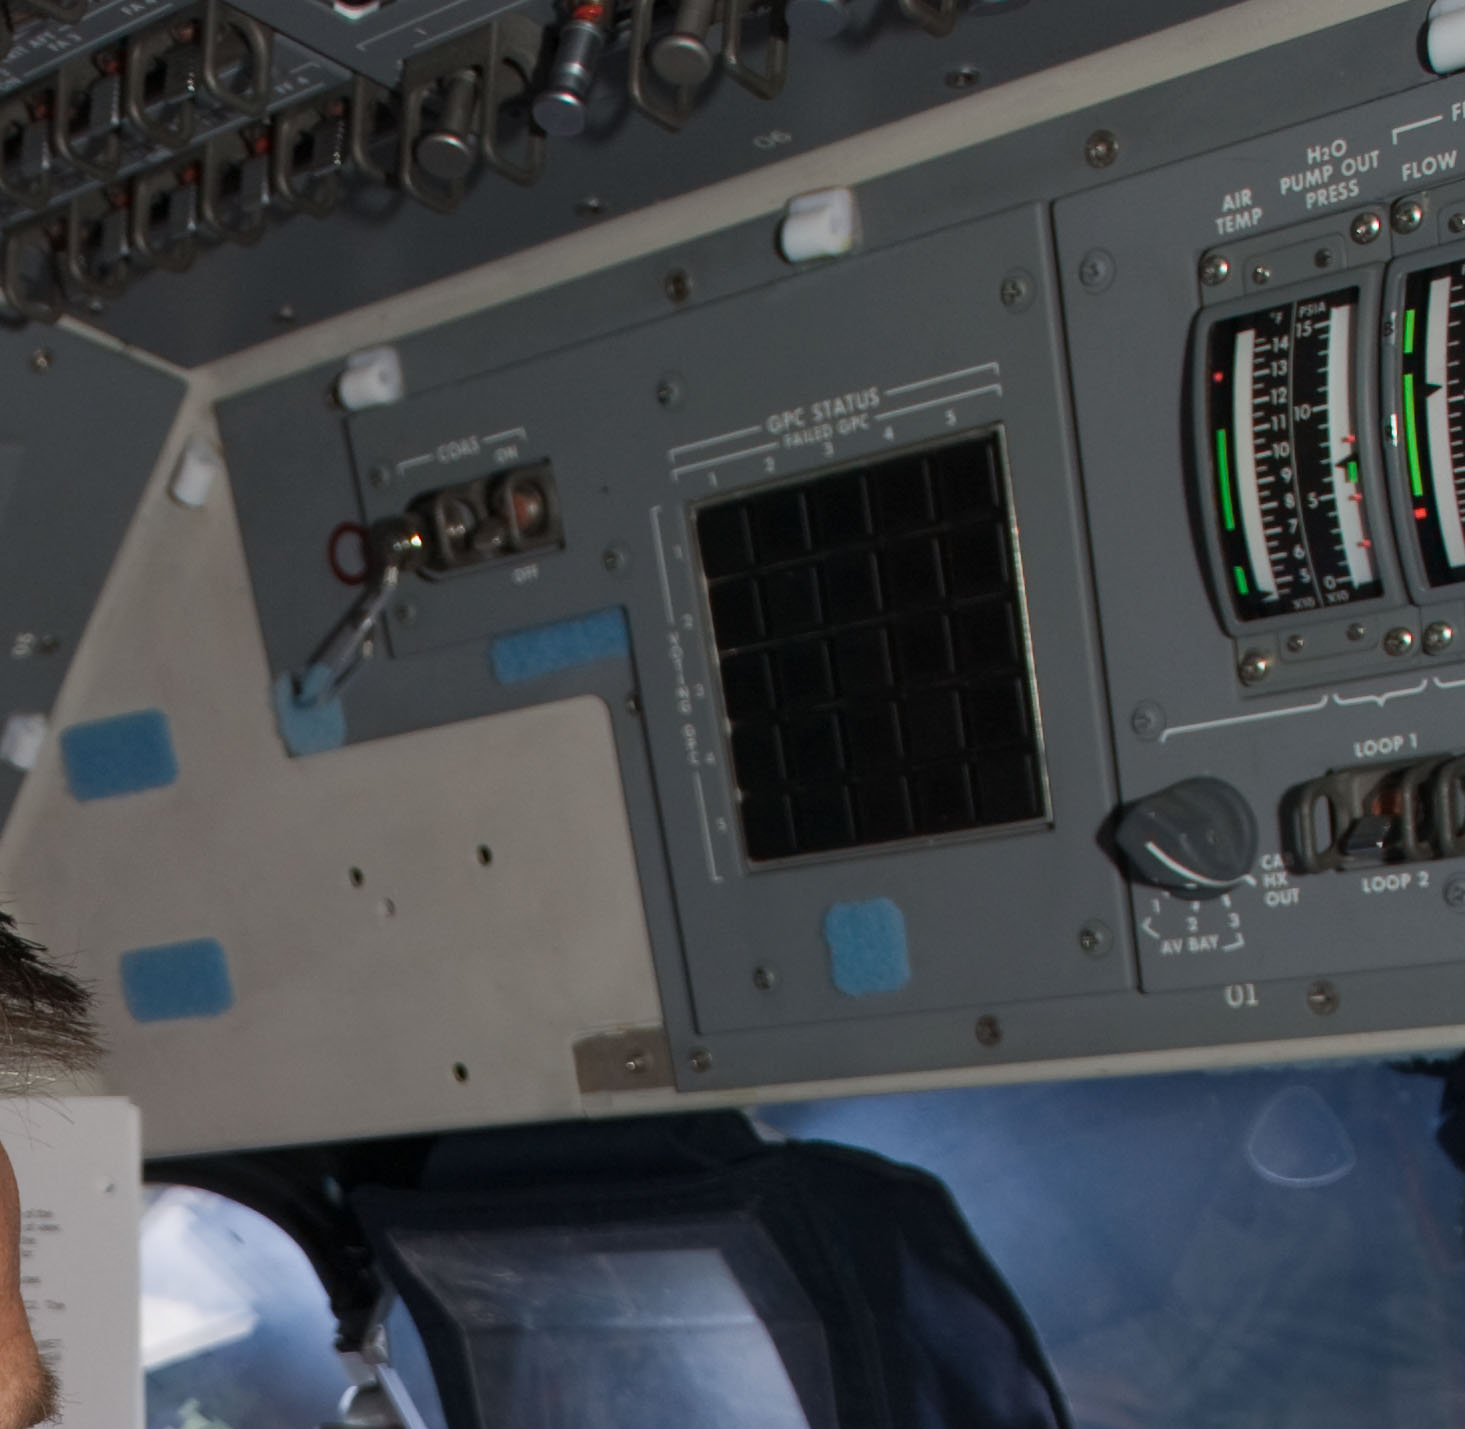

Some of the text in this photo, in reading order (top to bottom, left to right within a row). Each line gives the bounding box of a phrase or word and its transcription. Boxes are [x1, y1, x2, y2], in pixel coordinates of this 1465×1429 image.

[1280, 151, 1380, 196] PUMP OUT
[1402, 151, 1457, 182] FLOW
[1221, 189, 1253, 213] AIR
[1305, 180, 1360, 209] PRESS
[1216, 207, 1263, 236] TEMP
[1298, 300, 1326, 318] PSIA
[1295, 320, 1313, 338] 15
[1272, 335, 1289, 352] 14
[1271, 360, 1288, 377] 13
[1270, 387, 1288, 404] 12
[765, 386, 881, 435] GPC STATUS
[1294, 404, 1312, 421] 10
[1271, 413, 1288, 430] 11
[783, 413, 869, 450] FAILED GPC
[1273, 441, 1290, 458] 10
[1281, 467, 1292, 484] 9
[1284, 494, 1296, 510] 8
[1308, 492, 1320, 509] 5
[1288, 518, 1299, 535] 7
[1293, 544, 1305, 560] 6
[1300, 567, 1311, 583] 5
[1323, 573, 1335, 591] 0
[1353, 733, 1419, 759] LOOP 1
[1263, 870, 1289, 887] HX
[1362, 870, 1430, 894] LOOP 2
[1265, 888, 1301, 907] OUT
[1186, 917, 1199, 932] 2
[1228, 912, 1240, 928] 3
[1160, 935, 1219, 956] AV BAY
